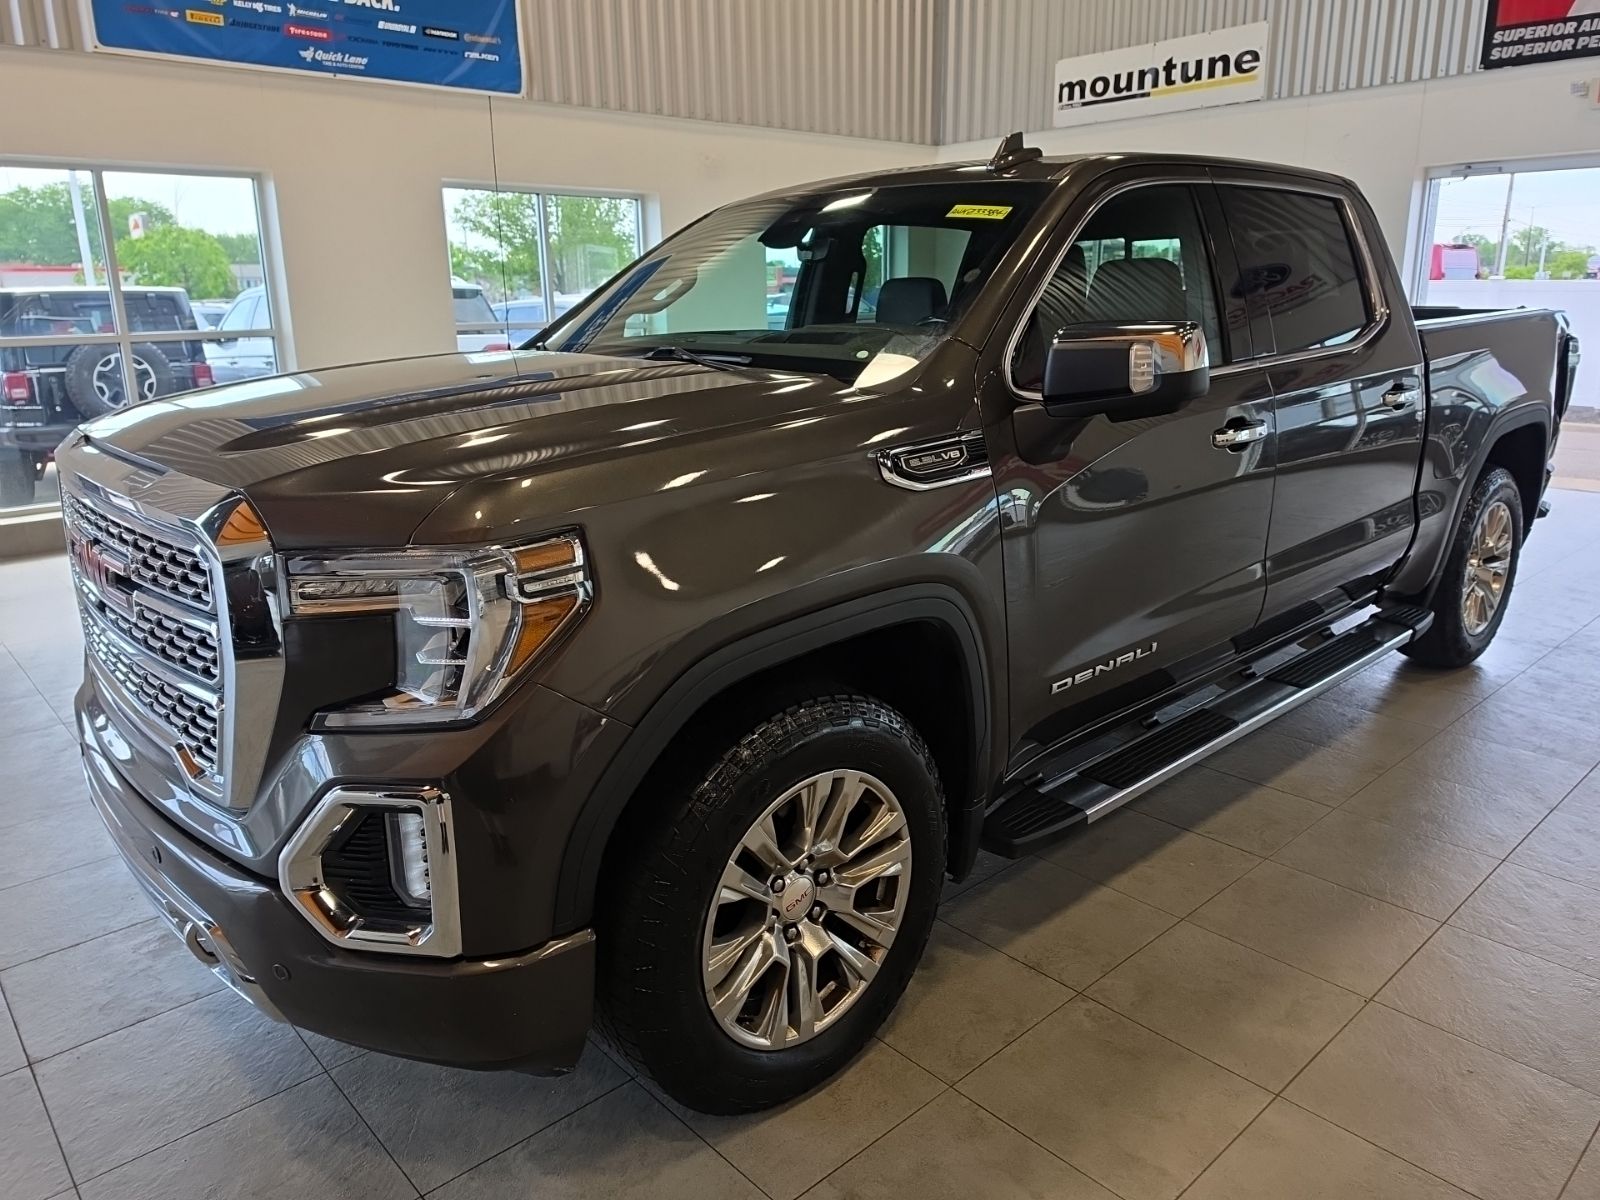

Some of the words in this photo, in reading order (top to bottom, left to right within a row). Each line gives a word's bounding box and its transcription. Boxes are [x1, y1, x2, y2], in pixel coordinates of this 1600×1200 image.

[344, 0, 400, 12] ACK.
[1492, 21, 1578, 44] SUPERIOR
[315, 49, 343, 62] Quick
[1489, 38, 1575, 60] SUPERIOR
[1576, 34, 1600, 49] PE
[1058, 49, 1260, 103] mountune
[1050, 641, 1158, 695] DENALI
[786, 886, 813, 912] GMC
